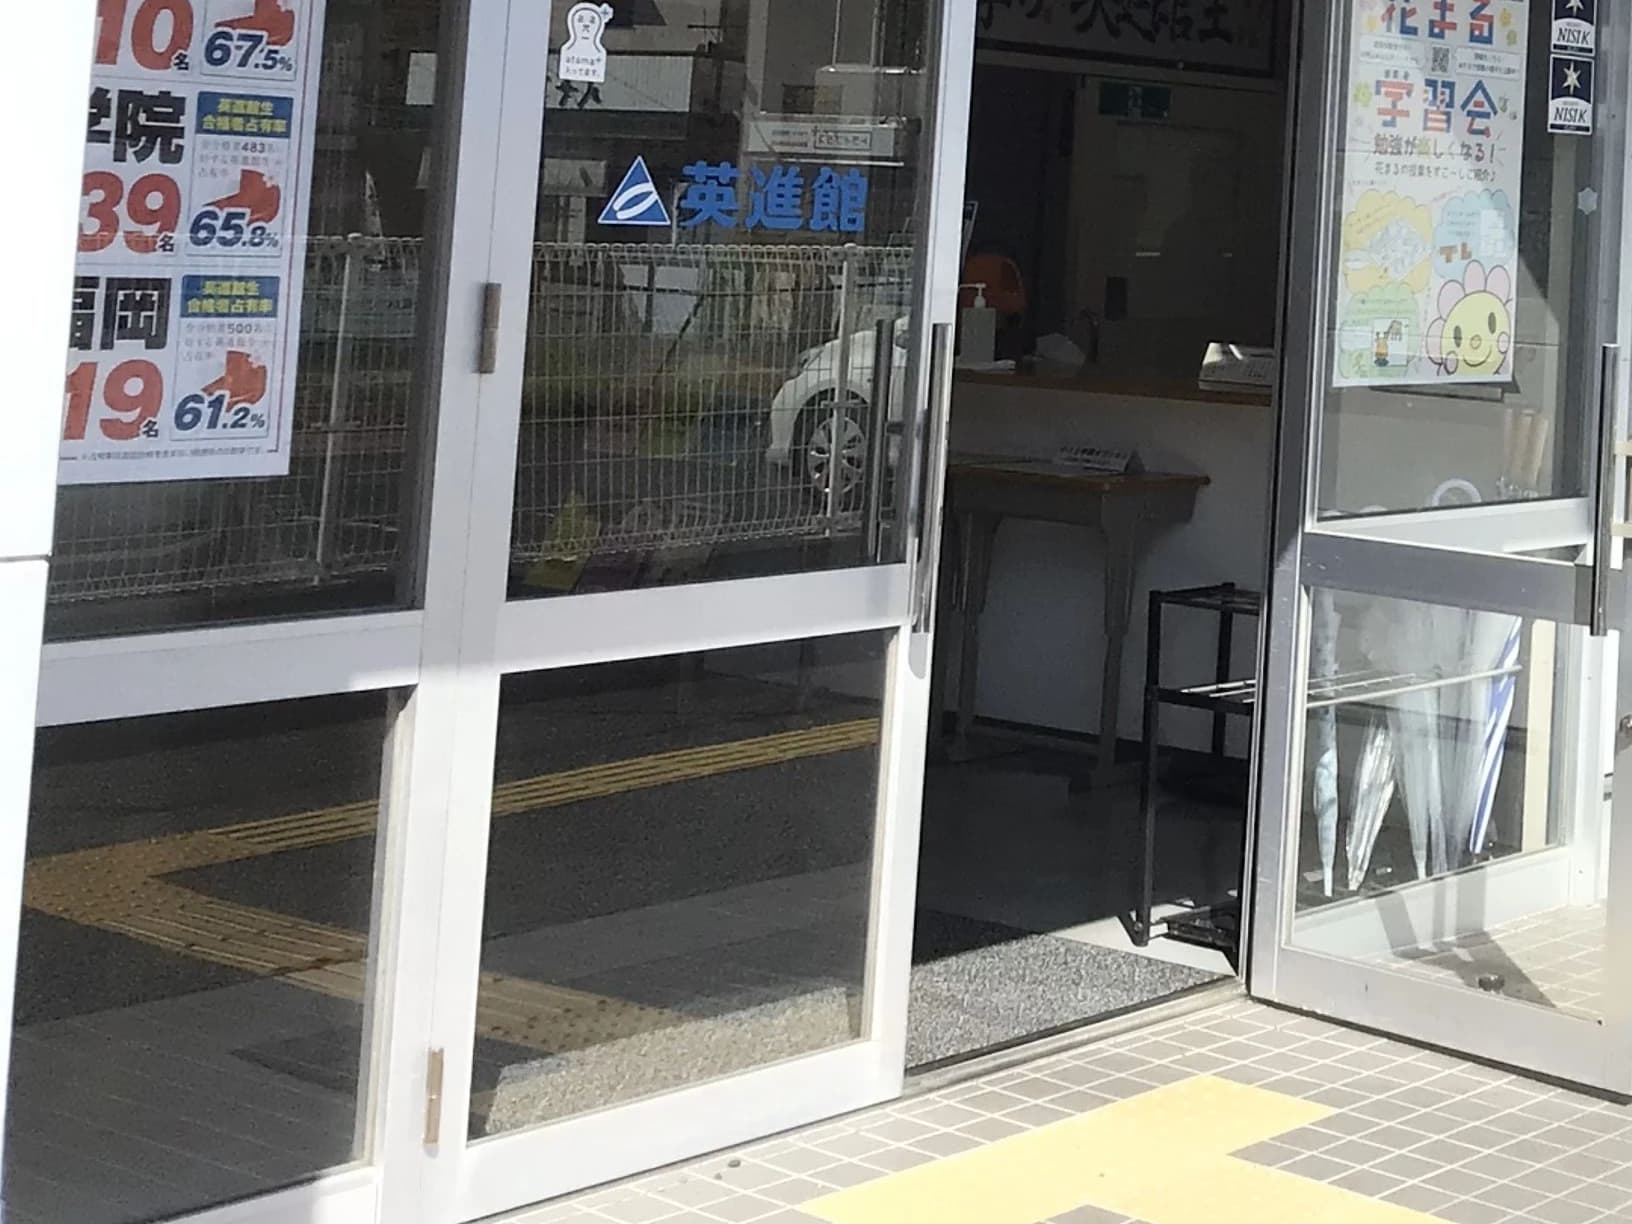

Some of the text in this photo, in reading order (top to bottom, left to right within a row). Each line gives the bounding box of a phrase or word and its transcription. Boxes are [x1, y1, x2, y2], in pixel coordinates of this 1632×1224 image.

[204, 31, 293, 72] 67.5%
[1557, 27, 1590, 45] NISIK
[1374, 70, 1498, 138] 学習会
[1554, 106, 1587, 124] NISIK
[680, 160, 868, 233] 英進館
[189, 210, 279, 248] 65.8%
[173, 393, 266, 432] 61.2%
